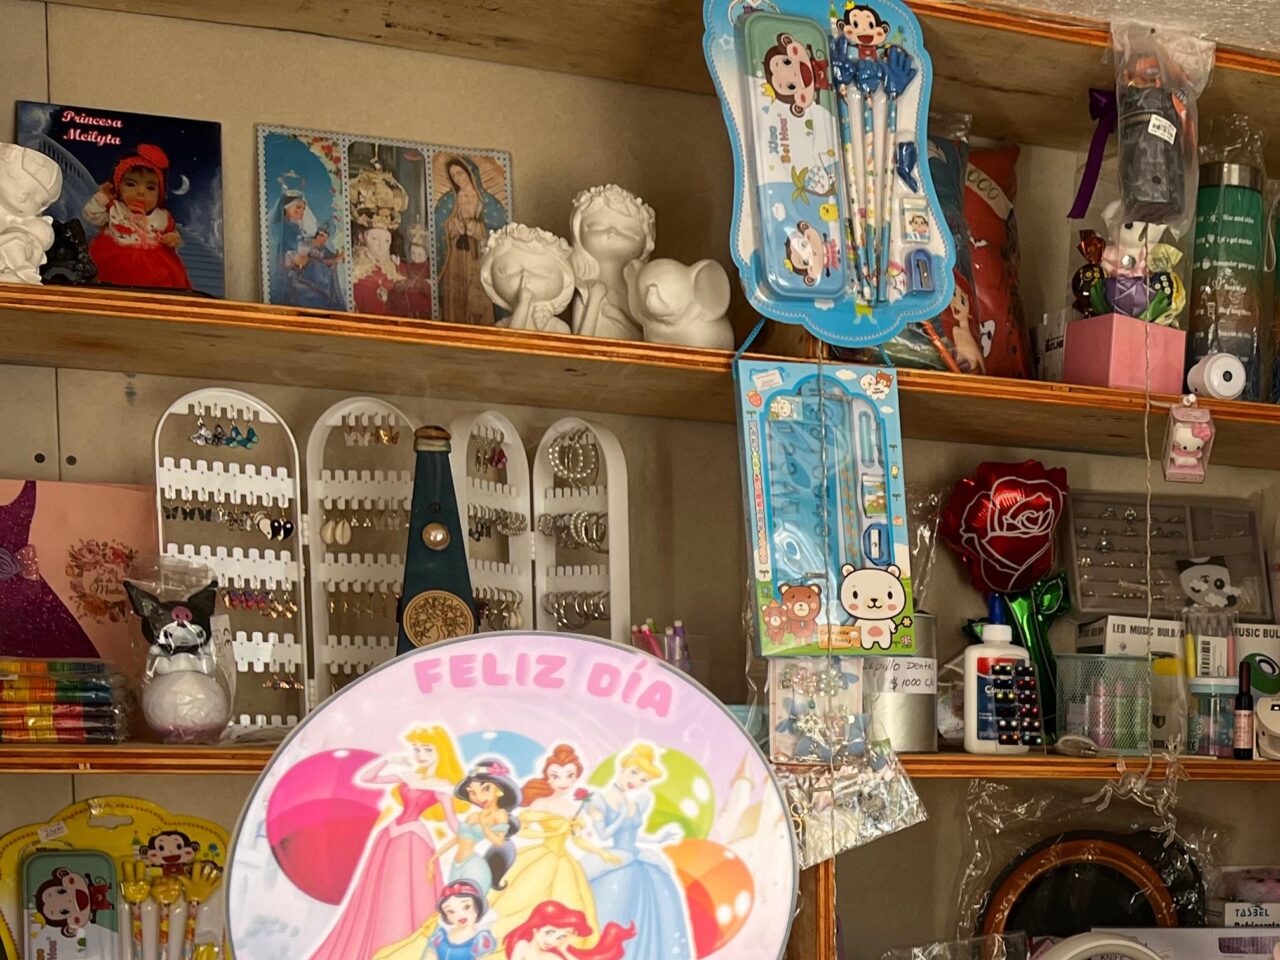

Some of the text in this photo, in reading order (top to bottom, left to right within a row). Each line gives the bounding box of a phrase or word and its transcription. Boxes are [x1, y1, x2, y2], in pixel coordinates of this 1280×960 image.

[61, 110, 123, 128] Princesa
[1112, 623, 1126, 634] LED
[1129, 625, 1154, 636] MUSIC
[413, 653, 673, 718] FELIZ DÍA
